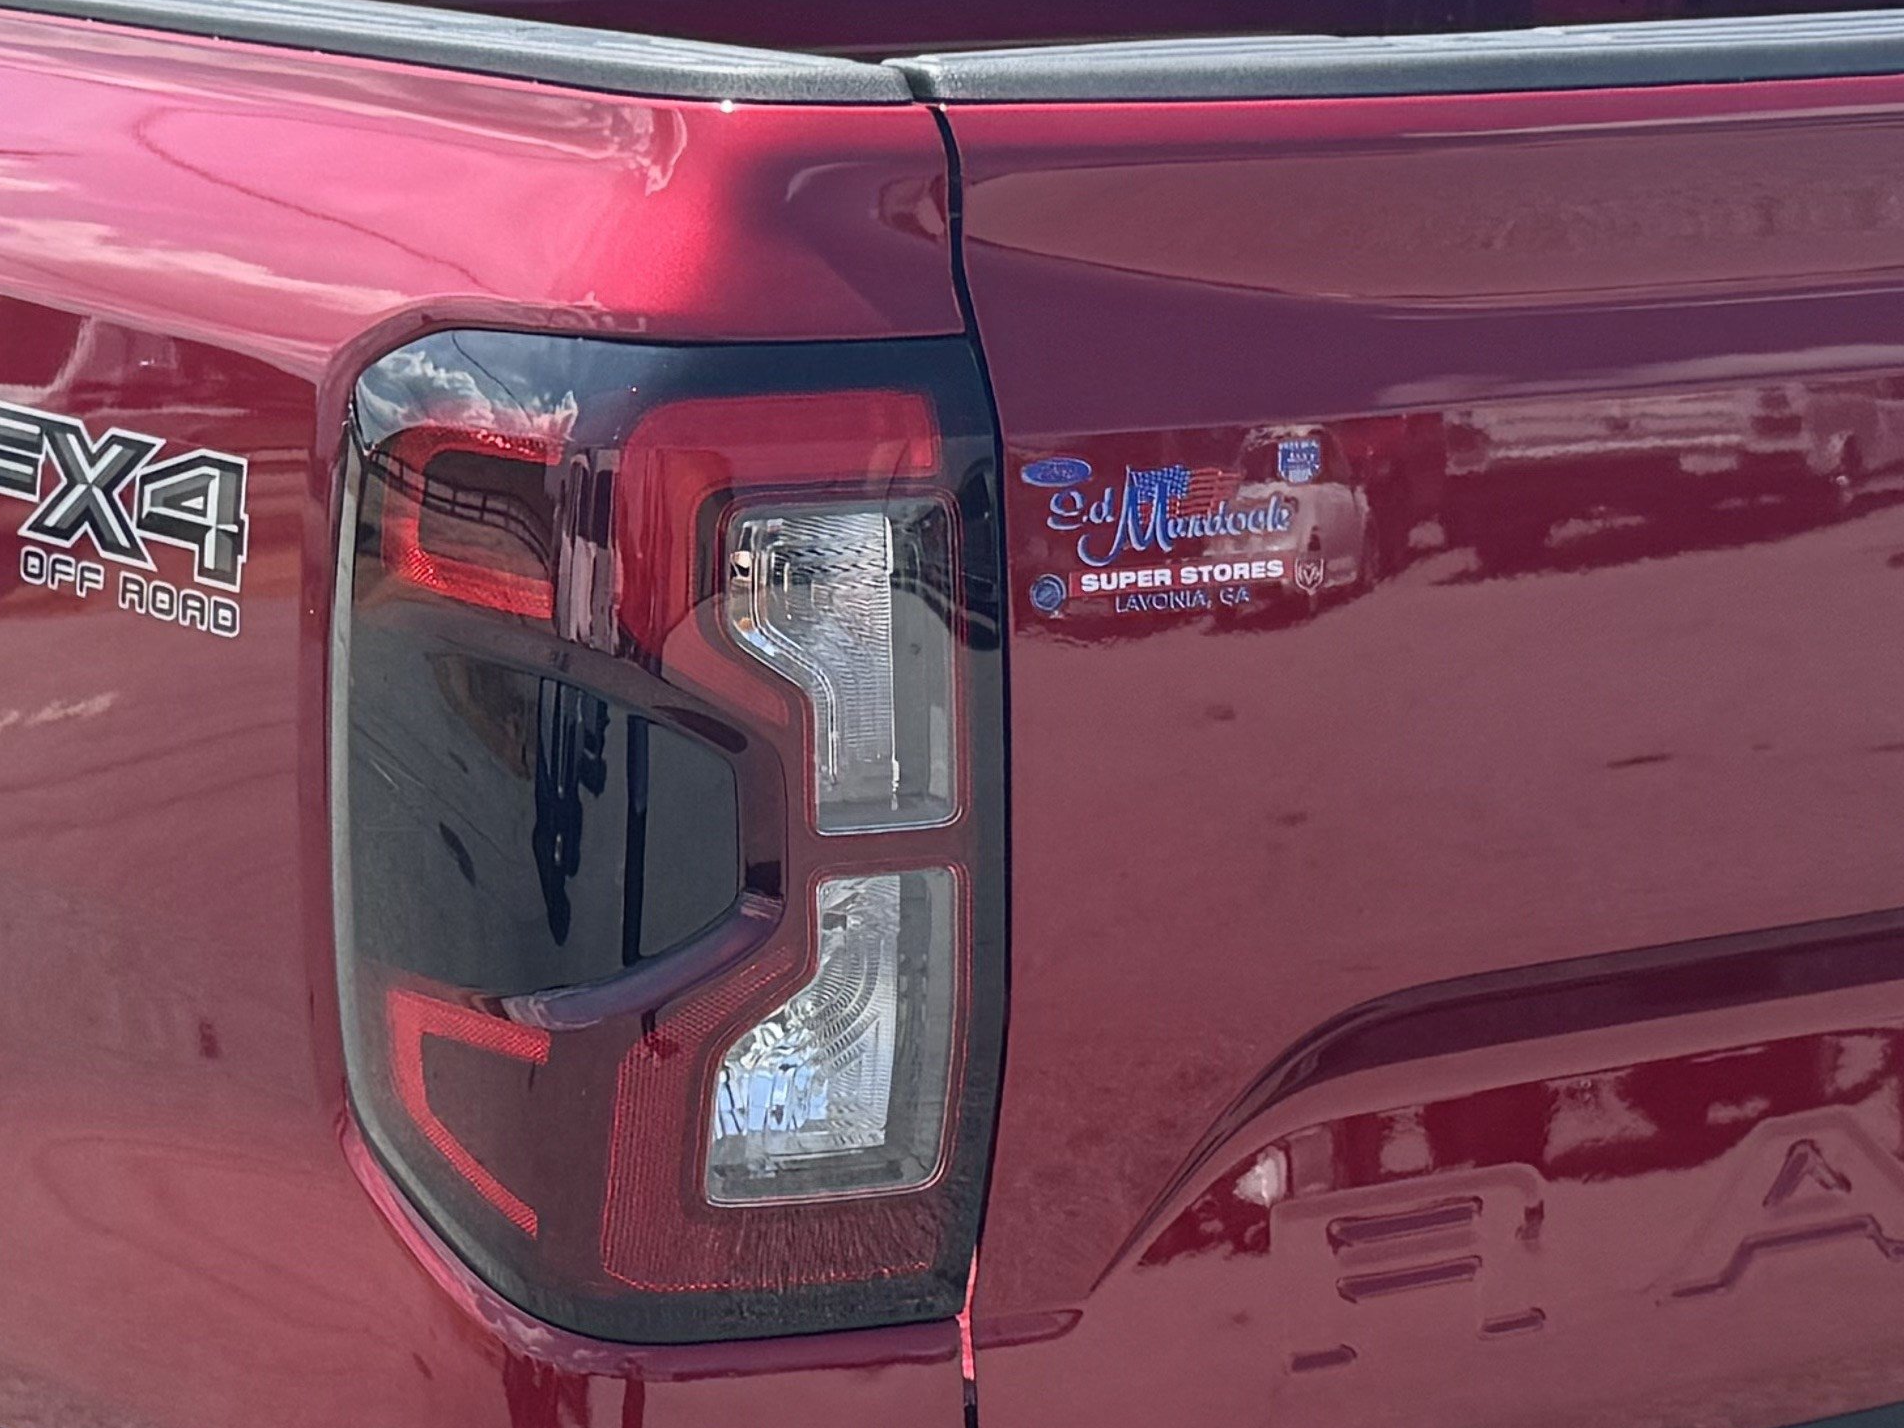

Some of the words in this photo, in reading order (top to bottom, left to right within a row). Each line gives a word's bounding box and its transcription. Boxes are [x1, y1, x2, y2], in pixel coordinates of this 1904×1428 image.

[20, 544, 105, 599] OFF
[118, 571, 241, 639] ROAD
[1080, 568, 1173, 594] SUPER
[1179, 558, 1285, 585] STORES
[1219, 586, 1250, 605] GA
